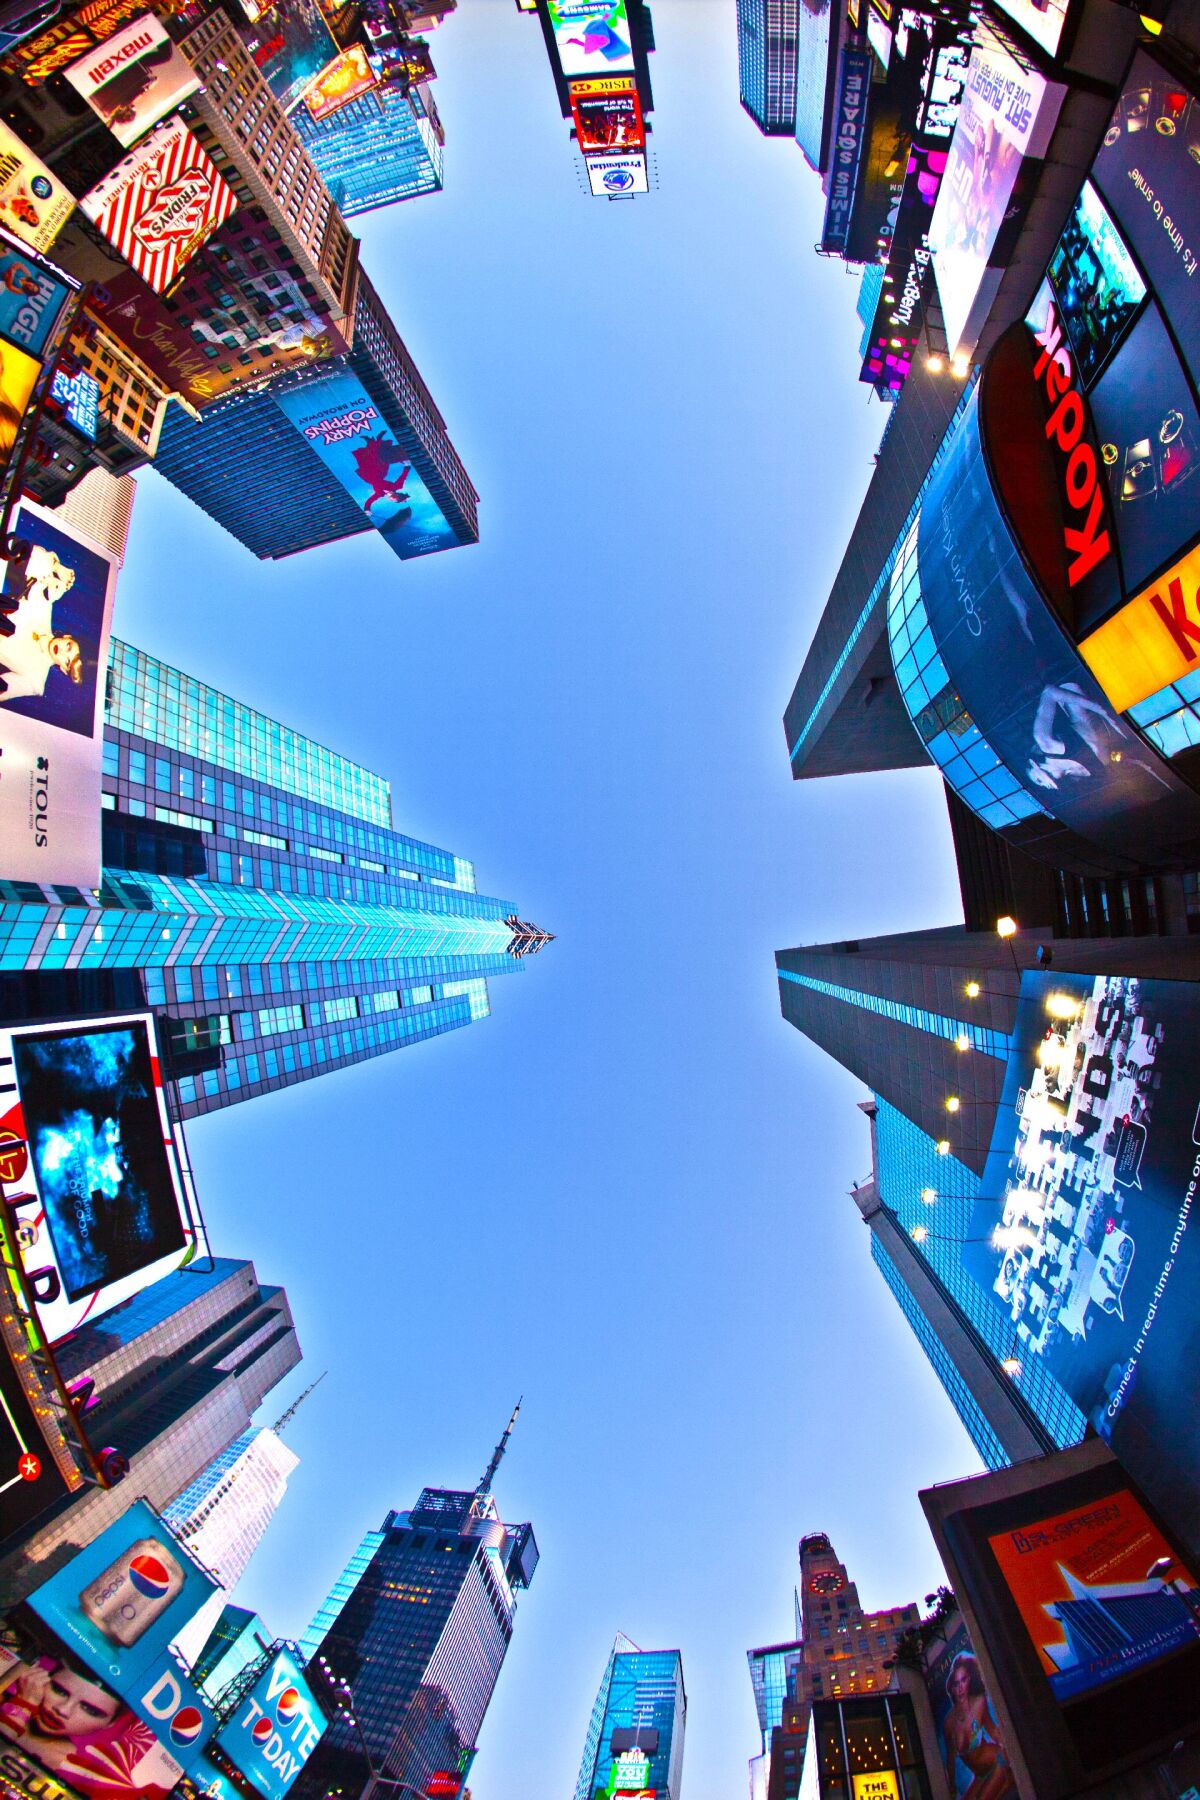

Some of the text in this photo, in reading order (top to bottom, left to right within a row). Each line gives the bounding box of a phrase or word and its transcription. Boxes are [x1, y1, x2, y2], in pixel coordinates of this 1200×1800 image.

[89, 32, 153, 84] maxell
[594, 79, 632, 91] HSBC
[968, 70, 1005, 110] AUGUST
[1003, 78, 1015, 94] ON
[1013, 86, 1031, 106] LIVE
[836, 75, 861, 165] SQUARE
[1004, 95, 1032, 133] SAT.
[100, 131, 182, 207] HERE ON 46TH STREET
[827, 171, 849, 237] TIMES
[1130, 167, 1200, 277] It's time to smile
[10, 274, 57, 344] HUGE
[241, 367, 286, 389] Colombian
[87, 378, 100, 441] WINNER!
[299, 397, 367, 425] ON BROADWAY
[303, 406, 378, 440] POPPINS
[324, 420, 371, 446] MARY
[1033, 300, 1111, 588] Kodak
[940, 495, 983, 638] Calvin Klein
[35, 775, 49, 848] TOUS
[1016, 993, 1129, 1338] FRIENDS
[67, 1178, 89, 1238] OF GOOD
[76, 1176, 92, 1221] TRIUMPH
[1107, 1356, 1137, 1418] Connect
[1132, 1338, 1145, 1354] in
[1141, 1256, 1177, 1338] real-time,
[1170, 1180, 1198, 1255] anytime
[1120, 1620, 1187, 1660] Broadway
[863, 1781, 888, 1793] THE
